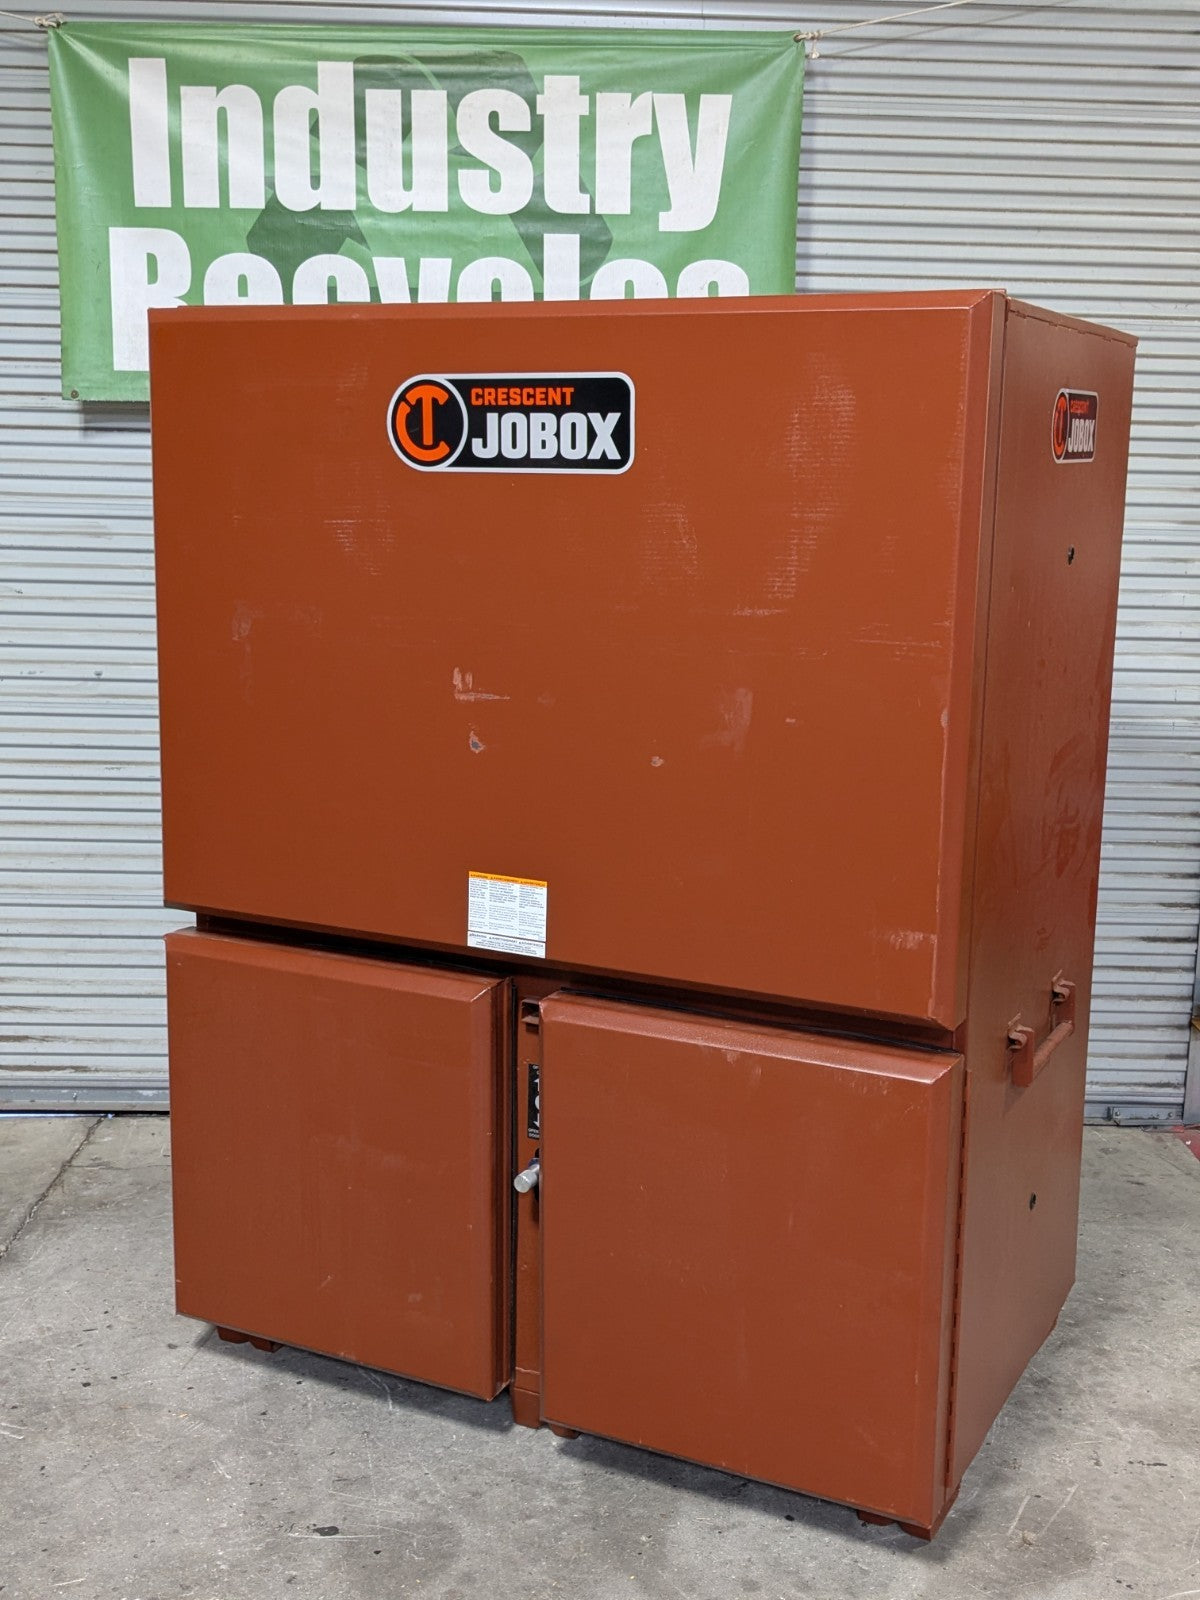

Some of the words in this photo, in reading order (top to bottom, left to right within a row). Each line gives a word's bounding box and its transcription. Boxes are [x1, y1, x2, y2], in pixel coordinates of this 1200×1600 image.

[127, 57, 733, 232] Industry
[470, 387, 575, 406] CRESCENT
[471, 412, 622, 460] JOBOX
[1068, 418, 1095, 453] JOBOX
